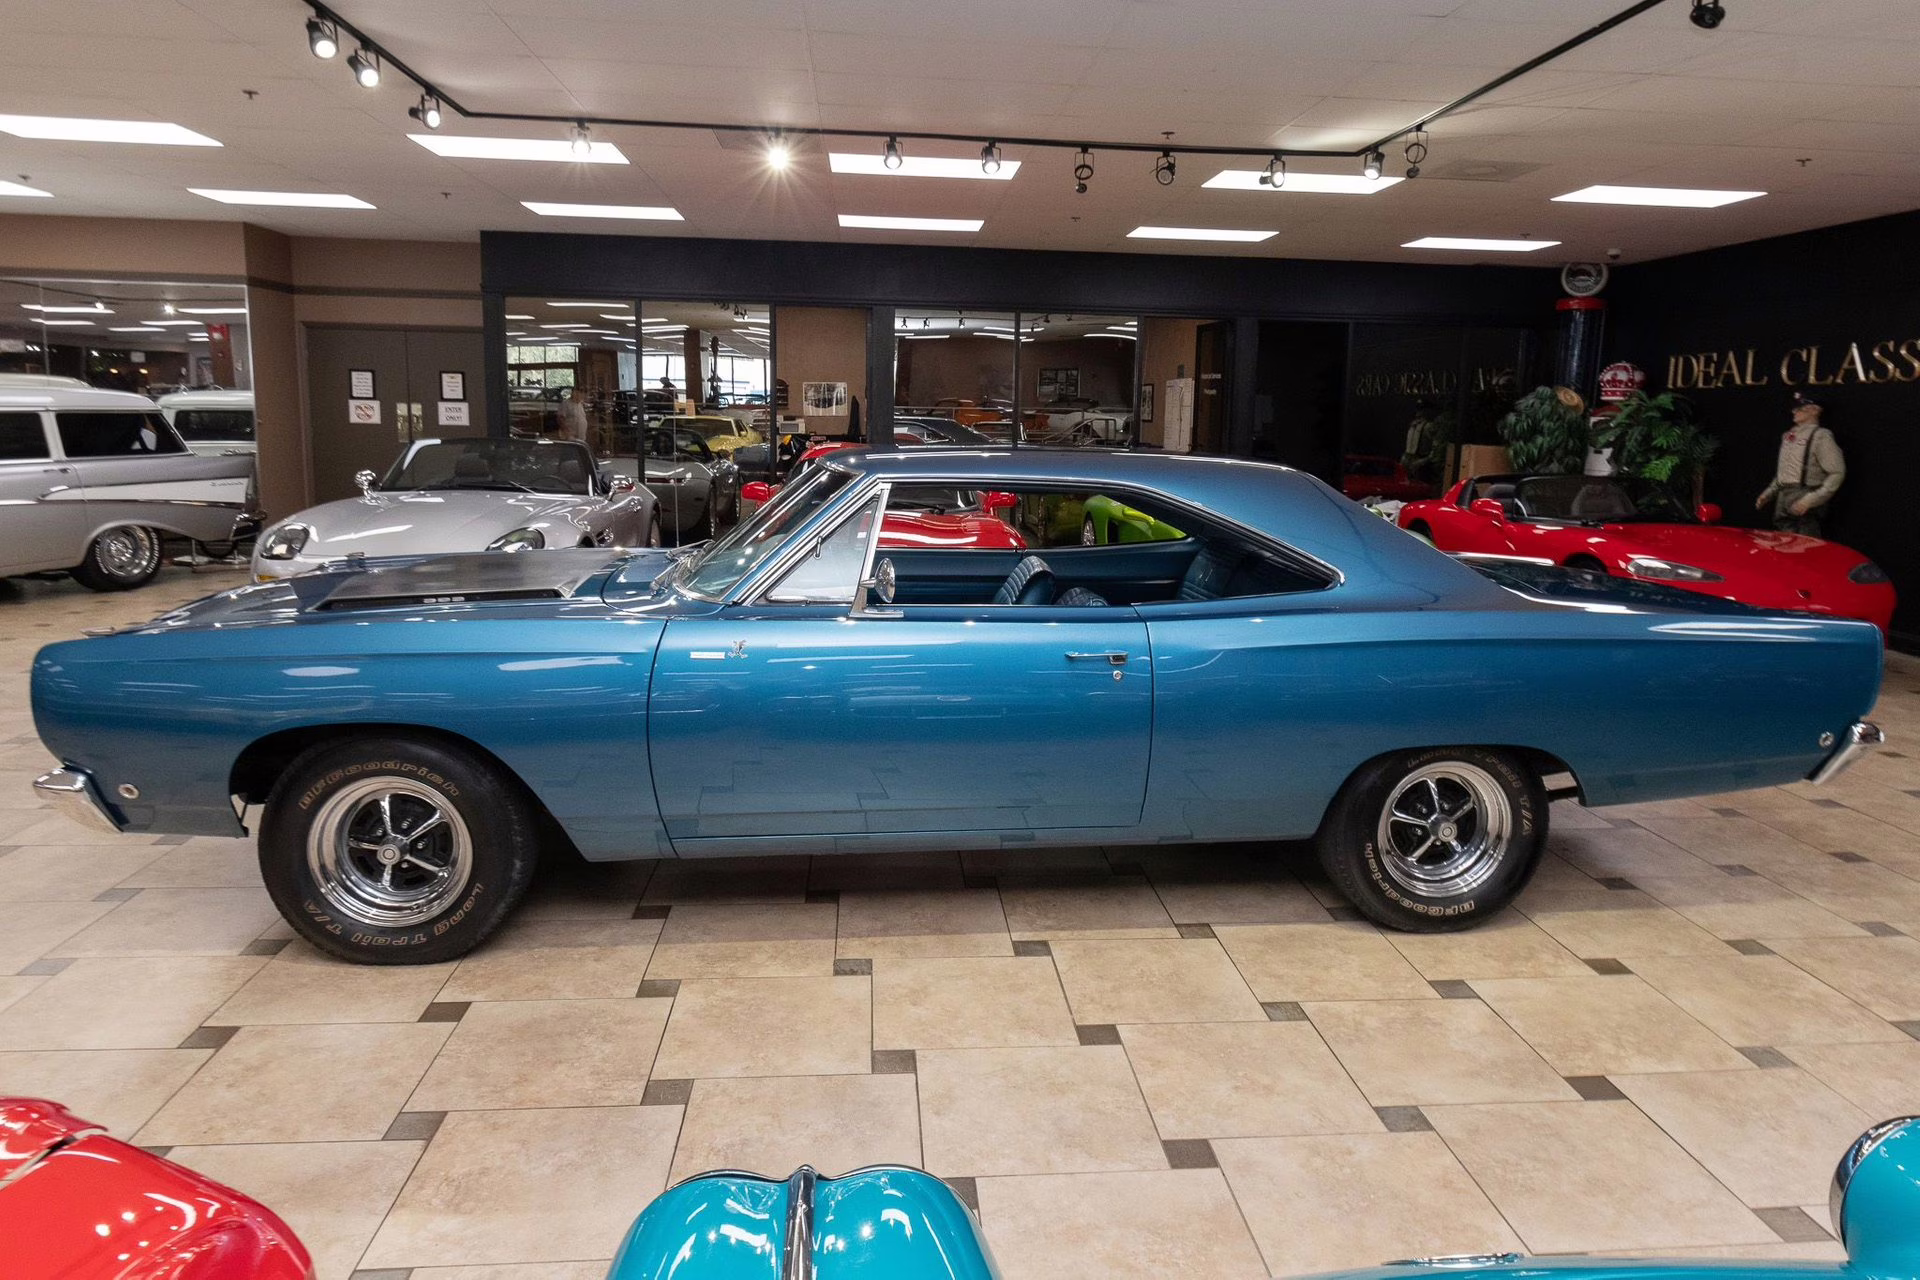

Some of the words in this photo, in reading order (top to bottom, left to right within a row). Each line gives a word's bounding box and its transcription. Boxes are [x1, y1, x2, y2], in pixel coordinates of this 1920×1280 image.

[1667, 349, 1768, 389] IDEAL
[1780, 339, 1920, 386] CLASS
[304, 900, 344, 936] T/A
